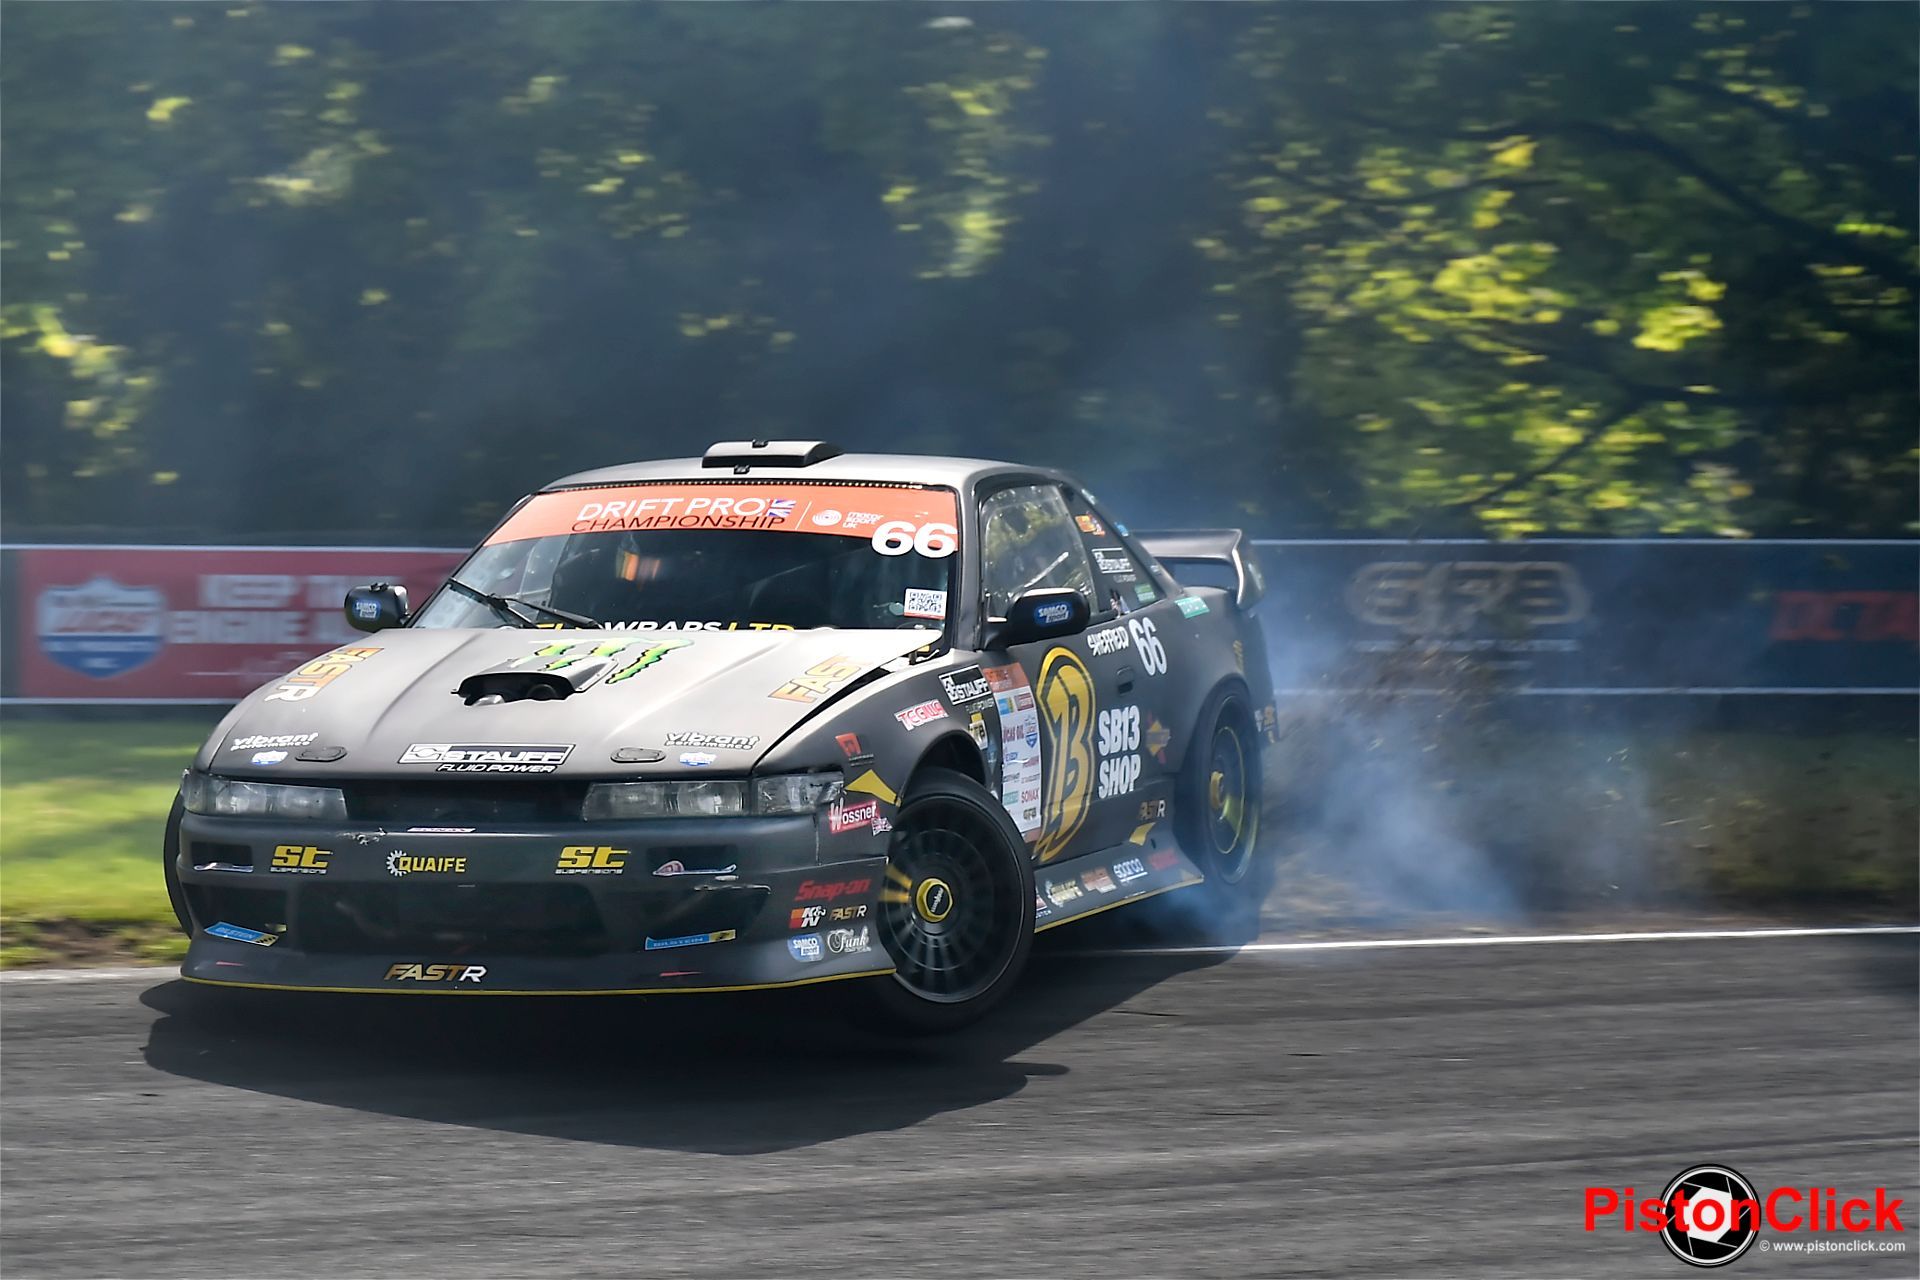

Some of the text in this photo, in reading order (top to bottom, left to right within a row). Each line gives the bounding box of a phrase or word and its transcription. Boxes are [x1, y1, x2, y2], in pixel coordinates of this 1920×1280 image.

[577, 497, 767, 520] DRIFT PRO
[571, 515, 786, 531] CHAMPIONSHIP
[871, 520, 959, 559] 66
[1038, 604, 1068, 618] SAMCO
[1129, 617, 1168, 676] 66
[953, 678, 992, 701] STAUFF
[1099, 705, 1140, 756] SB13
[234, 732, 319, 747] vibrant
[666, 732, 760, 747] vibrant
[442, 750, 566, 763] STAUFF
[437, 764, 557, 773] FLUID POWER
[1099, 754, 1141, 799] SHOP
[398, 856, 467, 873] QUAIFE
[794, 877, 873, 902] Snap-on
[830, 905, 867, 920] FASTR
[793, 937, 818, 949] SAMCO
[383, 964, 487, 982] FASTR
